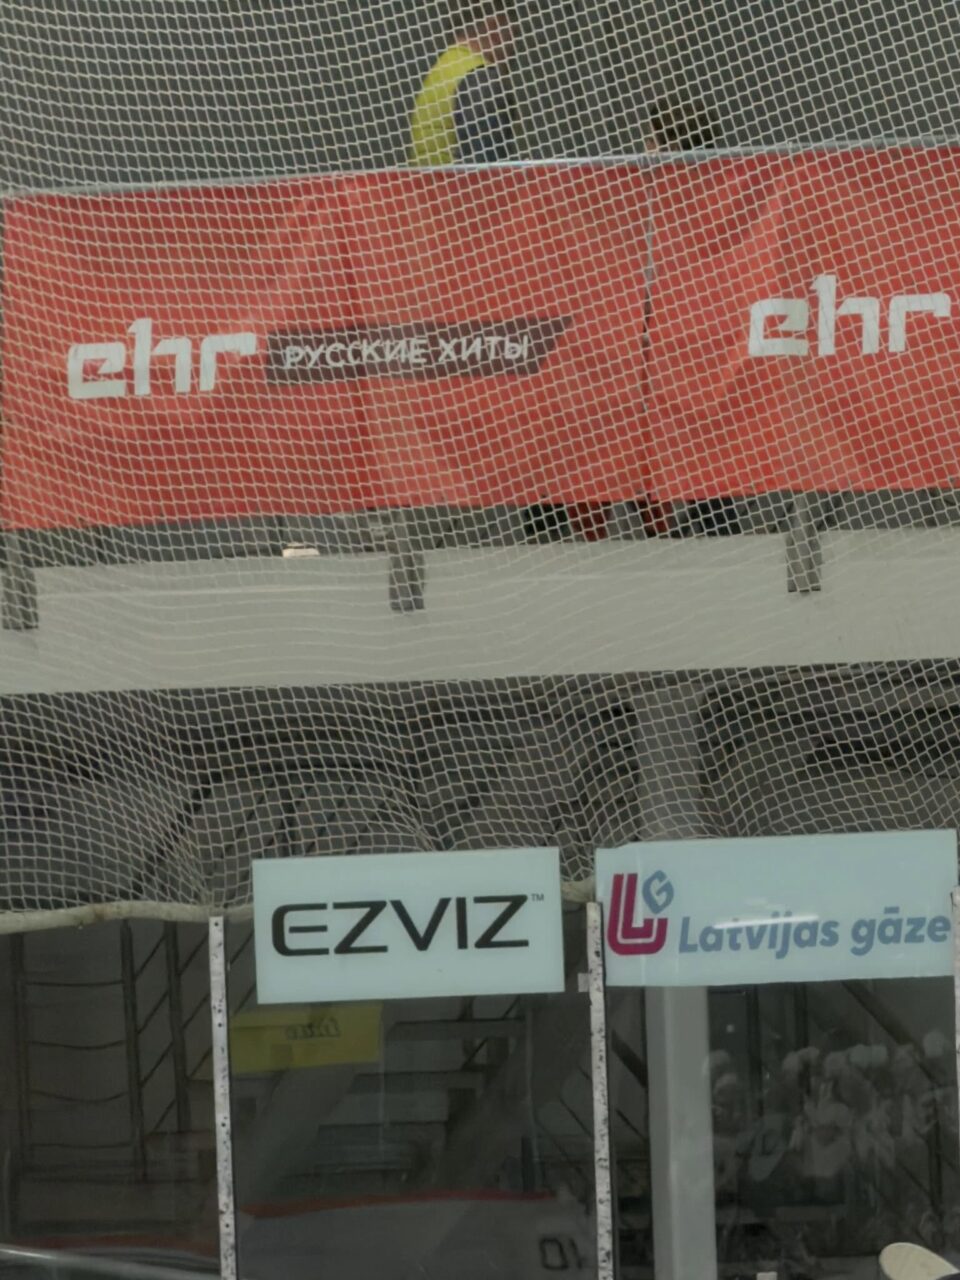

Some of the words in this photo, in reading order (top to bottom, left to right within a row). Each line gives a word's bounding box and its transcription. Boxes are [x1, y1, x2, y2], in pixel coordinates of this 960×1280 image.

[748, 275, 951, 357] ehr
[67, 318, 256, 398] ehr
[284, 335, 428, 369] РУССКИЕ
[439, 333, 530, 362] ХИТЫ
[272, 895, 530, 957] EZVIZ
[679, 911, 839, 959] Latvijas
[851, 906, 951, 957] gāze
